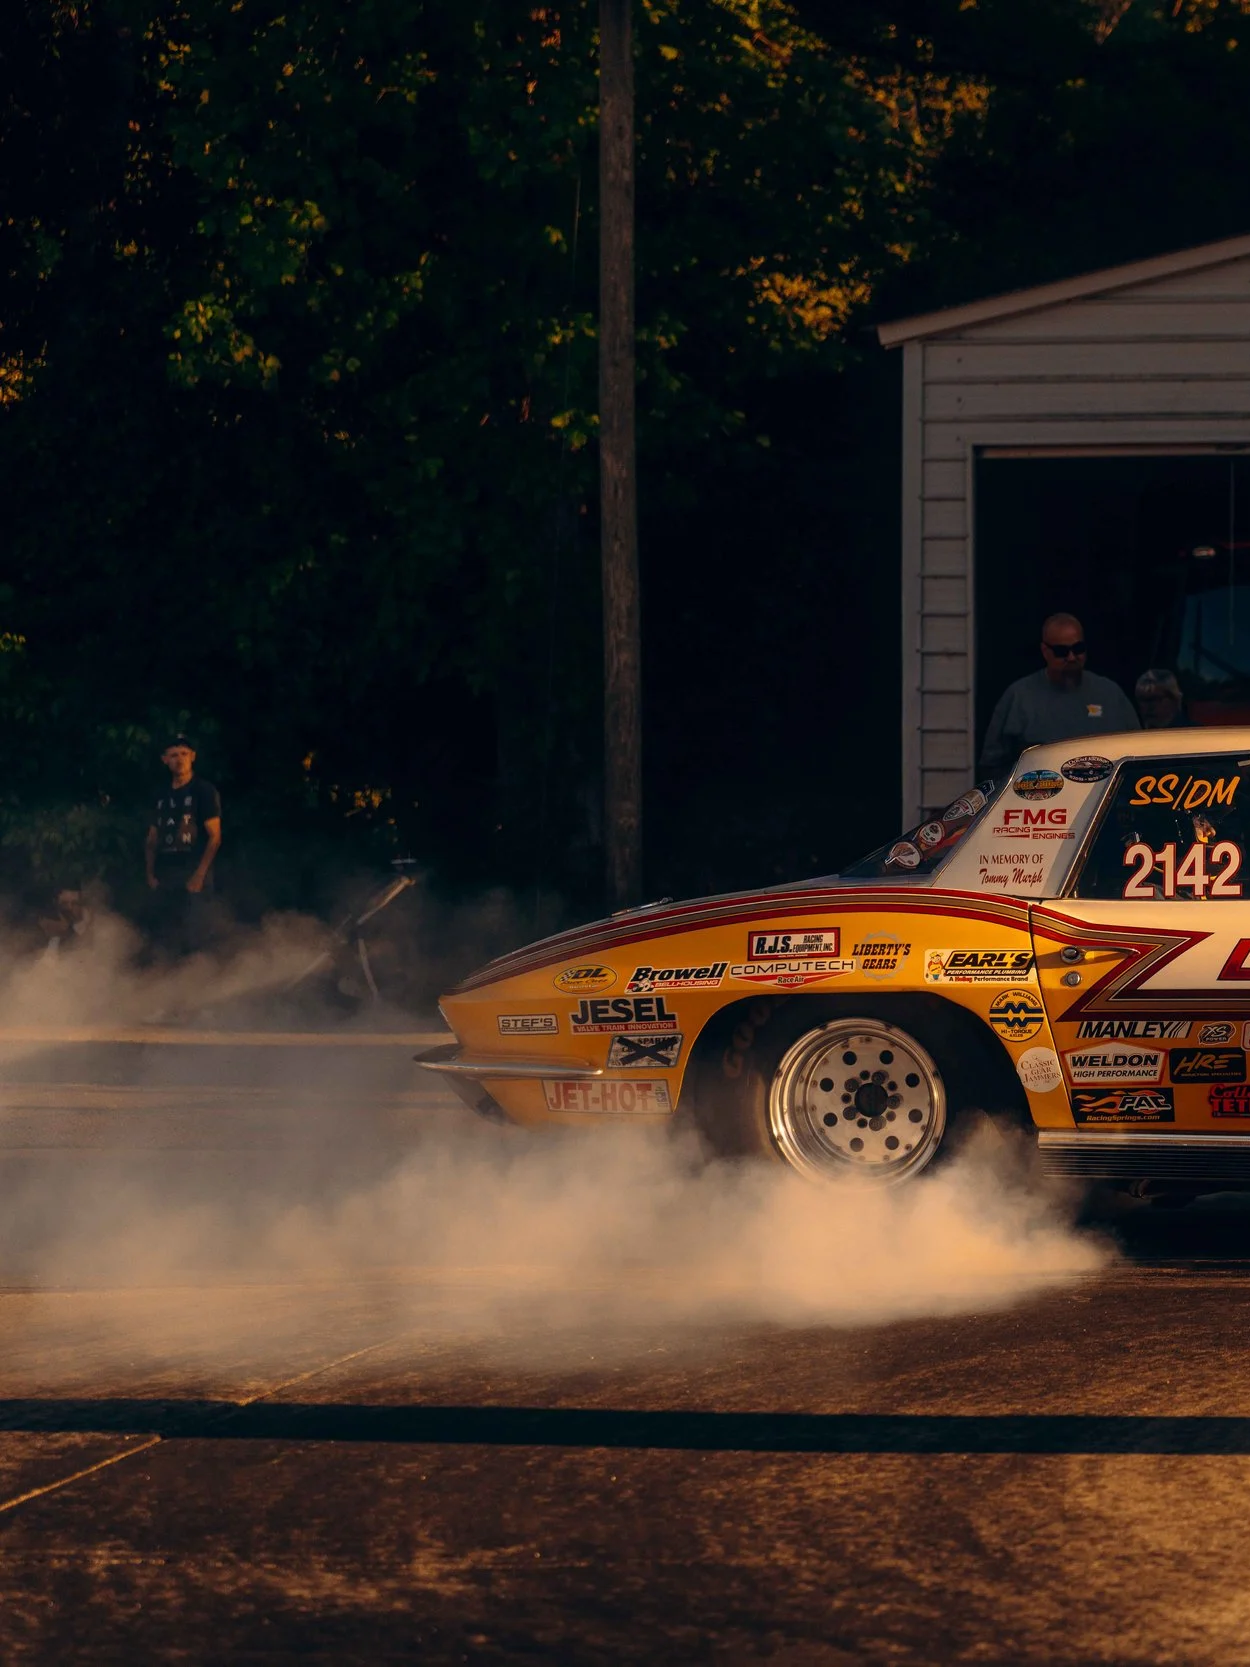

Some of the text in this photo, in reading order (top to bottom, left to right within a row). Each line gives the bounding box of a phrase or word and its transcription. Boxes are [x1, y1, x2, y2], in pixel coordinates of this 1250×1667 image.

[1129, 775, 1241, 810] SS/DM
[1003, 808, 1067, 825] FMG
[992, 826, 1031, 834] RACING
[979, 853, 1044, 865] IN MEMORY OF
[1123, 841, 1242, 899] 2142
[979, 868, 1009, 888] Tommy
[803, 934, 824, 943] RACING
[851, 943, 912, 956] LIBERTY'S
[862, 958, 898, 970] GEARS
[948, 952, 1031, 968] EARL'S
[630, 962, 729, 983] Browell
[730, 960, 854, 976] COMPUTECH
[653, 979, 719, 988] BELLHOUSING
[995, 991, 1038, 1007] MARK WILLIAMS
[570, 997, 677, 1025] JESEL
[501, 1017, 554, 1028] STEF'S
[628, 1022, 674, 1030] INNOVATION
[1081, 1021, 1172, 1038] MANLEY
[1204, 1025, 1228, 1038] XS
[1071, 1054, 1159, 1067] WELDON
[1030, 1066, 1052, 1076] GEAR
[1073, 1069, 1158, 1078] HIGH PERFORMANCE
[548, 1082, 652, 1112] JET-HOT
[1118, 1095, 1173, 1111] PAC
[1086, 1114, 1161, 1122] RacingSprings.com
